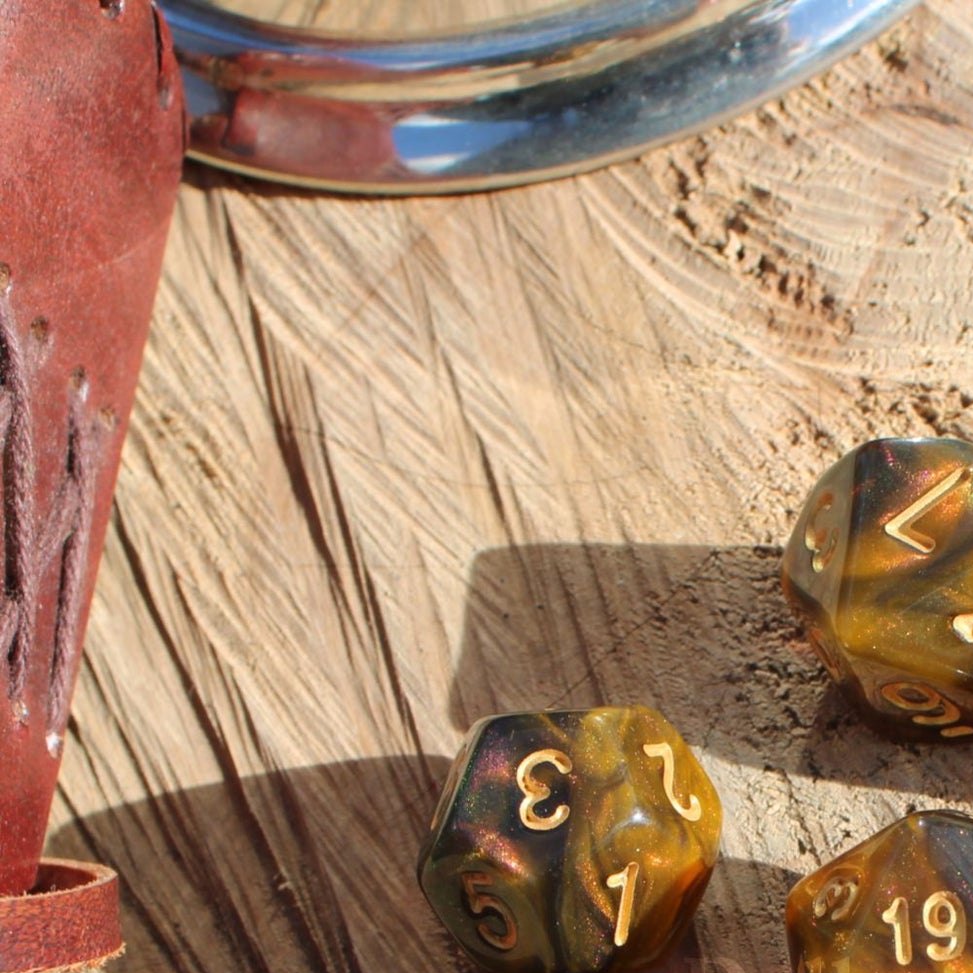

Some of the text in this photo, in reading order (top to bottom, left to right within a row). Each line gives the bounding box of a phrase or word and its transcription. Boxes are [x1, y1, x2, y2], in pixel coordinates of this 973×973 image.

[516, 748, 573, 831] 3
[461, 871, 517, 950] 5
[606, 861, 640, 947] 1
[882, 890, 967, 966] 19
